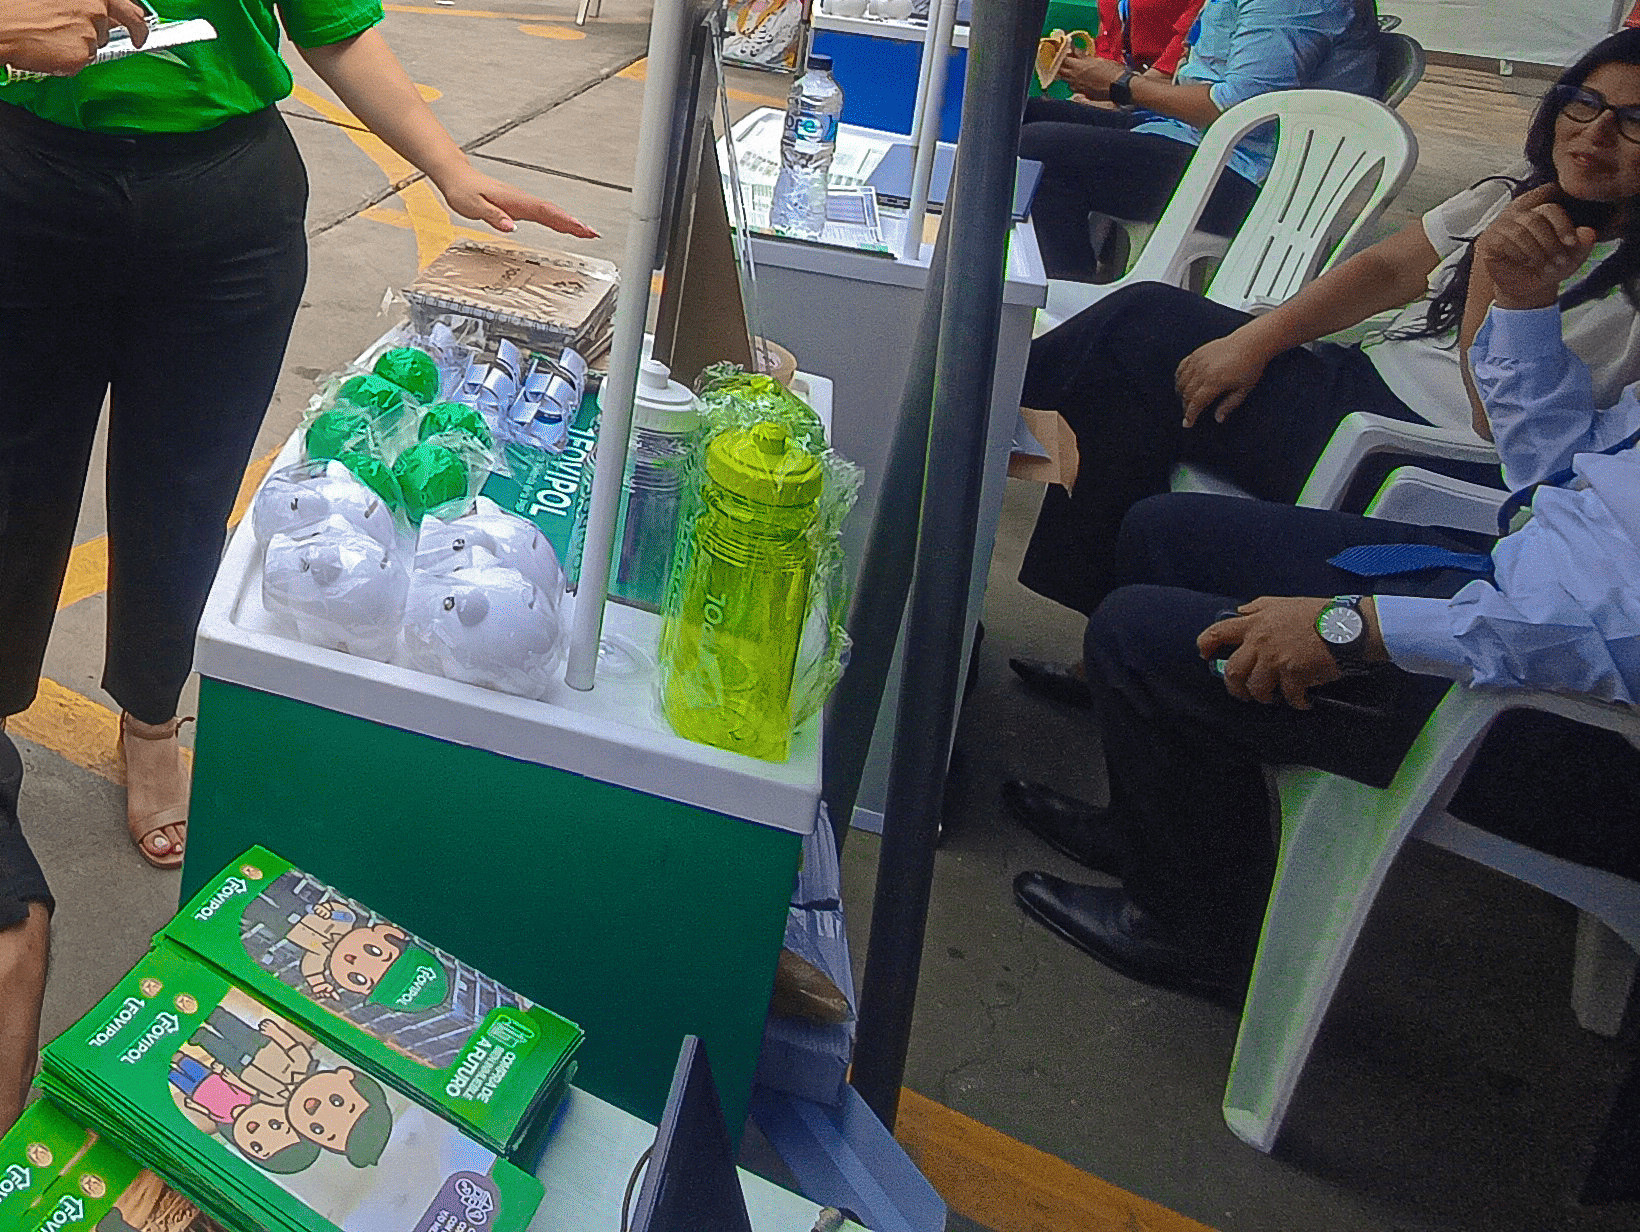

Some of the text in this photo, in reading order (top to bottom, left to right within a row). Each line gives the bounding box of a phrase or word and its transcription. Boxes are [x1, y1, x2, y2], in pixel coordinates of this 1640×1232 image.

[194, 876, 247, 921] FOVIPOL
[395, 965, 437, 1006] FOVIPOL
[88, 997, 145, 1047] FOVIPOL
[120, 1012, 179, 1064] FOVIPOL
[445, 1035, 492, 1097] A FUTURO
